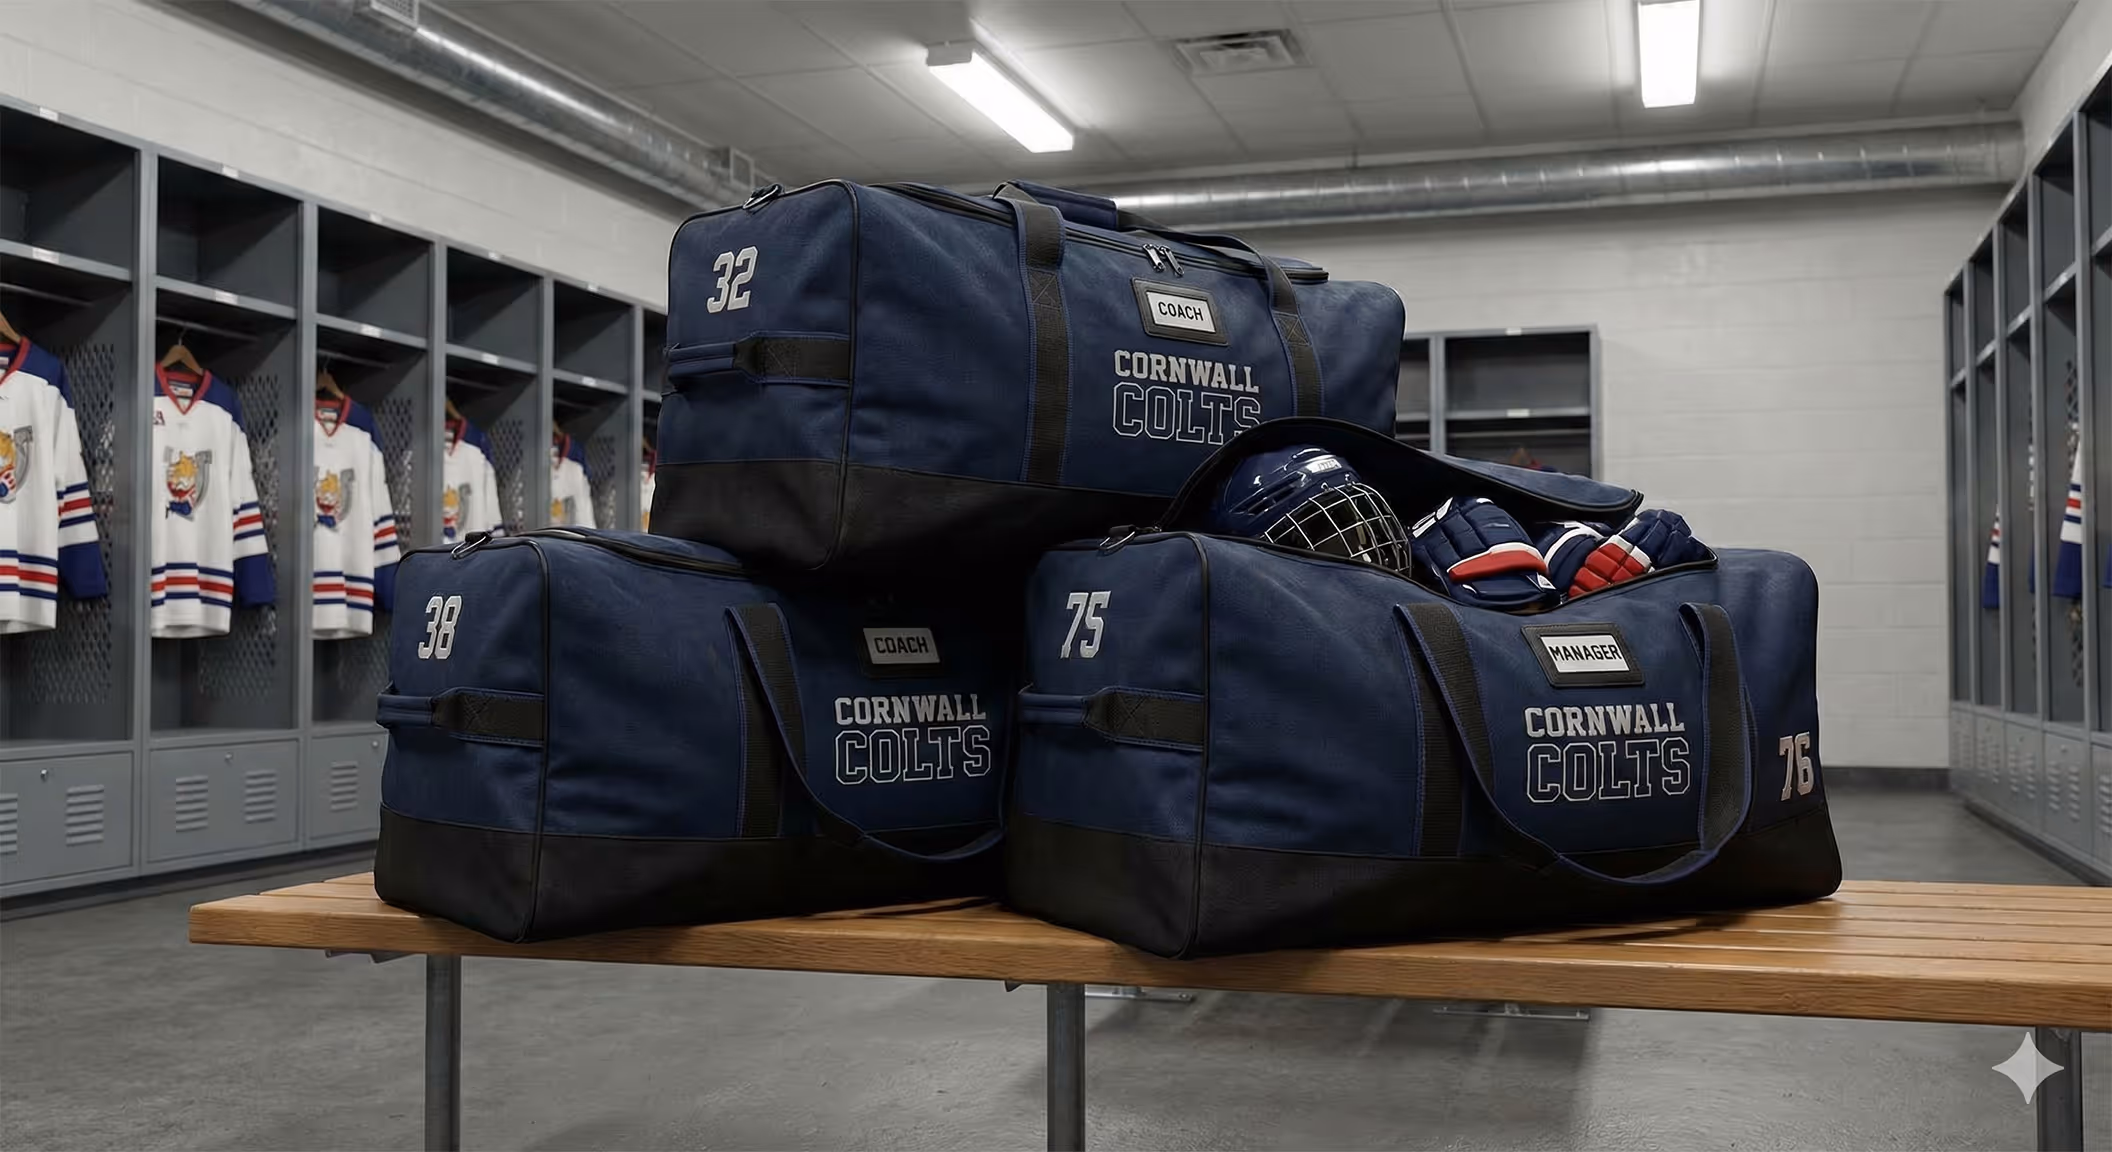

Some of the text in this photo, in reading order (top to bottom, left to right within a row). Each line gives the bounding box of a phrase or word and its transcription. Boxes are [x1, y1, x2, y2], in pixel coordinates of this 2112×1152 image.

[707, 246, 758, 313] 32
[1158, 301, 1204, 321] COACH
[1114, 350, 1259, 393] CORNWALL
[1113, 381, 1261, 445] COLTS
[418, 595, 462, 659] 38
[873, 636, 929, 654] COACH
[1061, 591, 1111, 659] 75
[1549, 644, 1622, 661] MANAGER
[834, 694, 986, 725] CORNWALL
[1525, 702, 1685, 737] CORNWALL
[835, 725, 991, 785] COLTS
[1527, 737, 1690, 803] COLTS
[1779, 731, 1815, 801] 76
